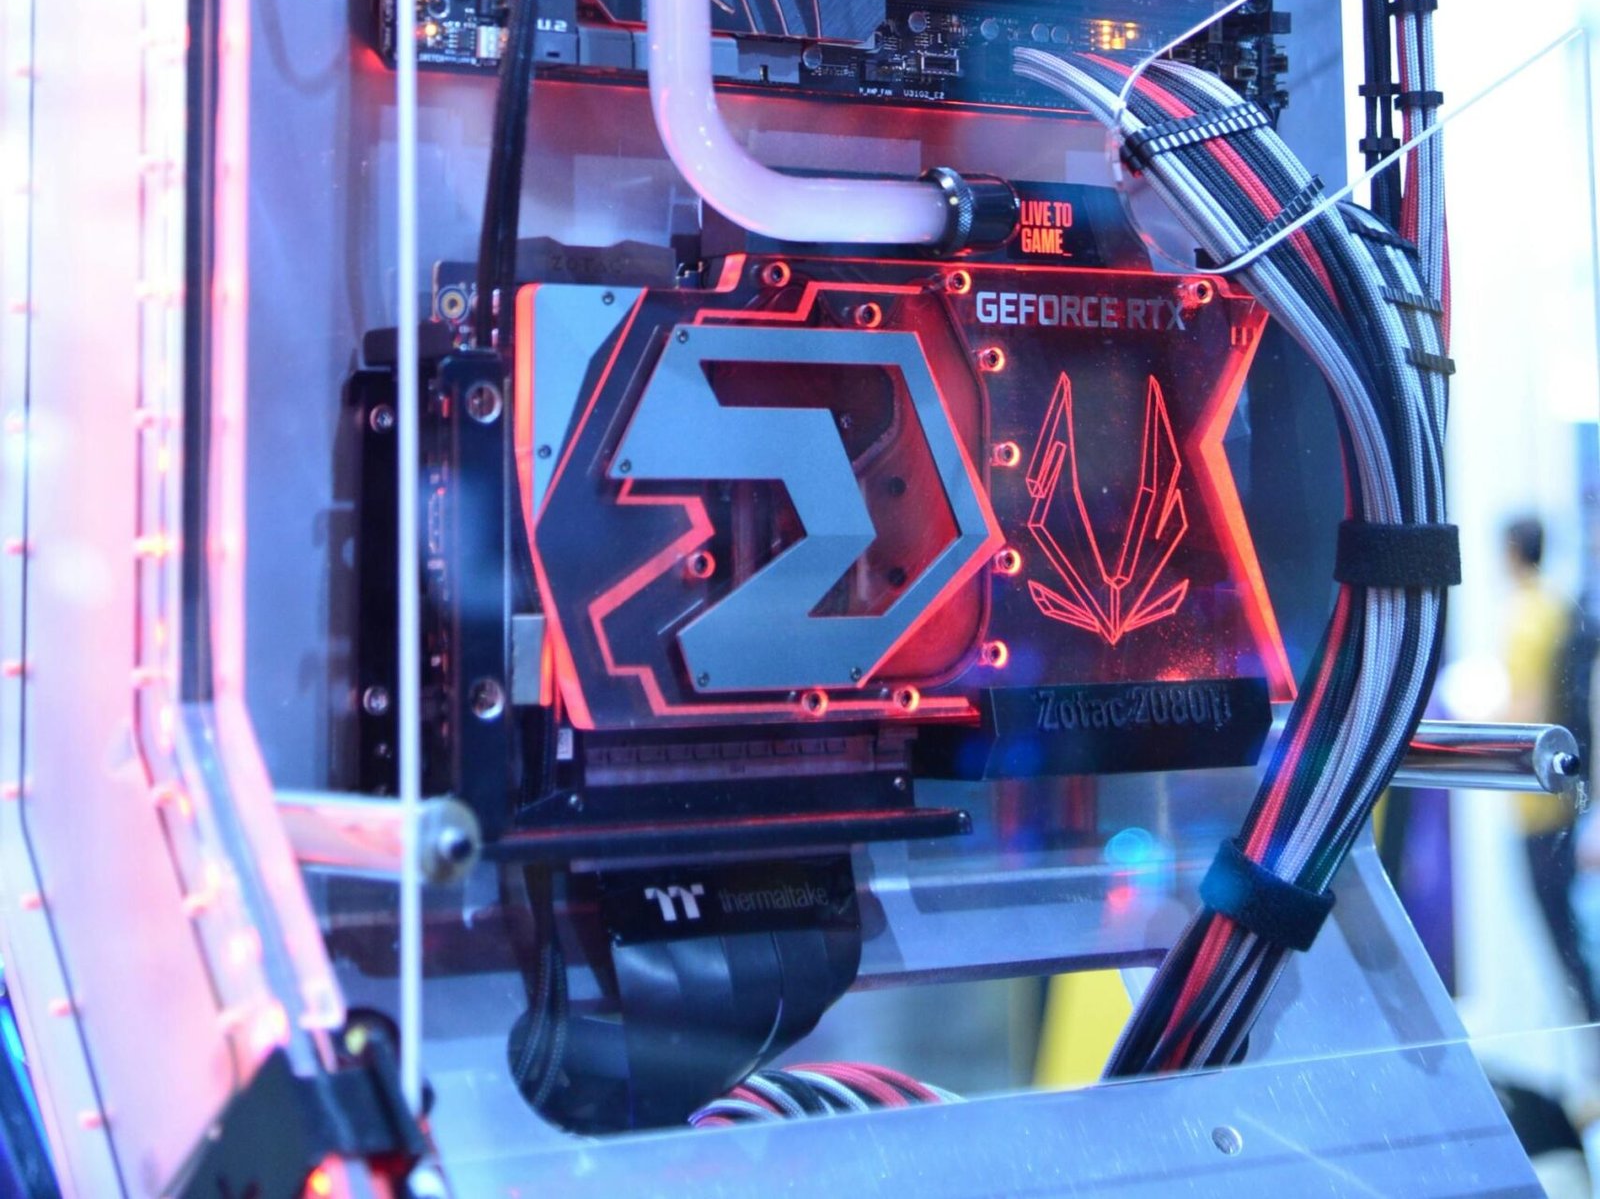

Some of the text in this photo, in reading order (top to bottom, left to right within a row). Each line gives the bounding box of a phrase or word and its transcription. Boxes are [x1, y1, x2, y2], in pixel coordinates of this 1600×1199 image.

[537, 18, 567, 32] U.2
[1021, 201, 1072, 227] LIVE TO
[976, 291, 1186, 331] GEFORCE RTX
[718, 882, 829, 914] thermaltake
